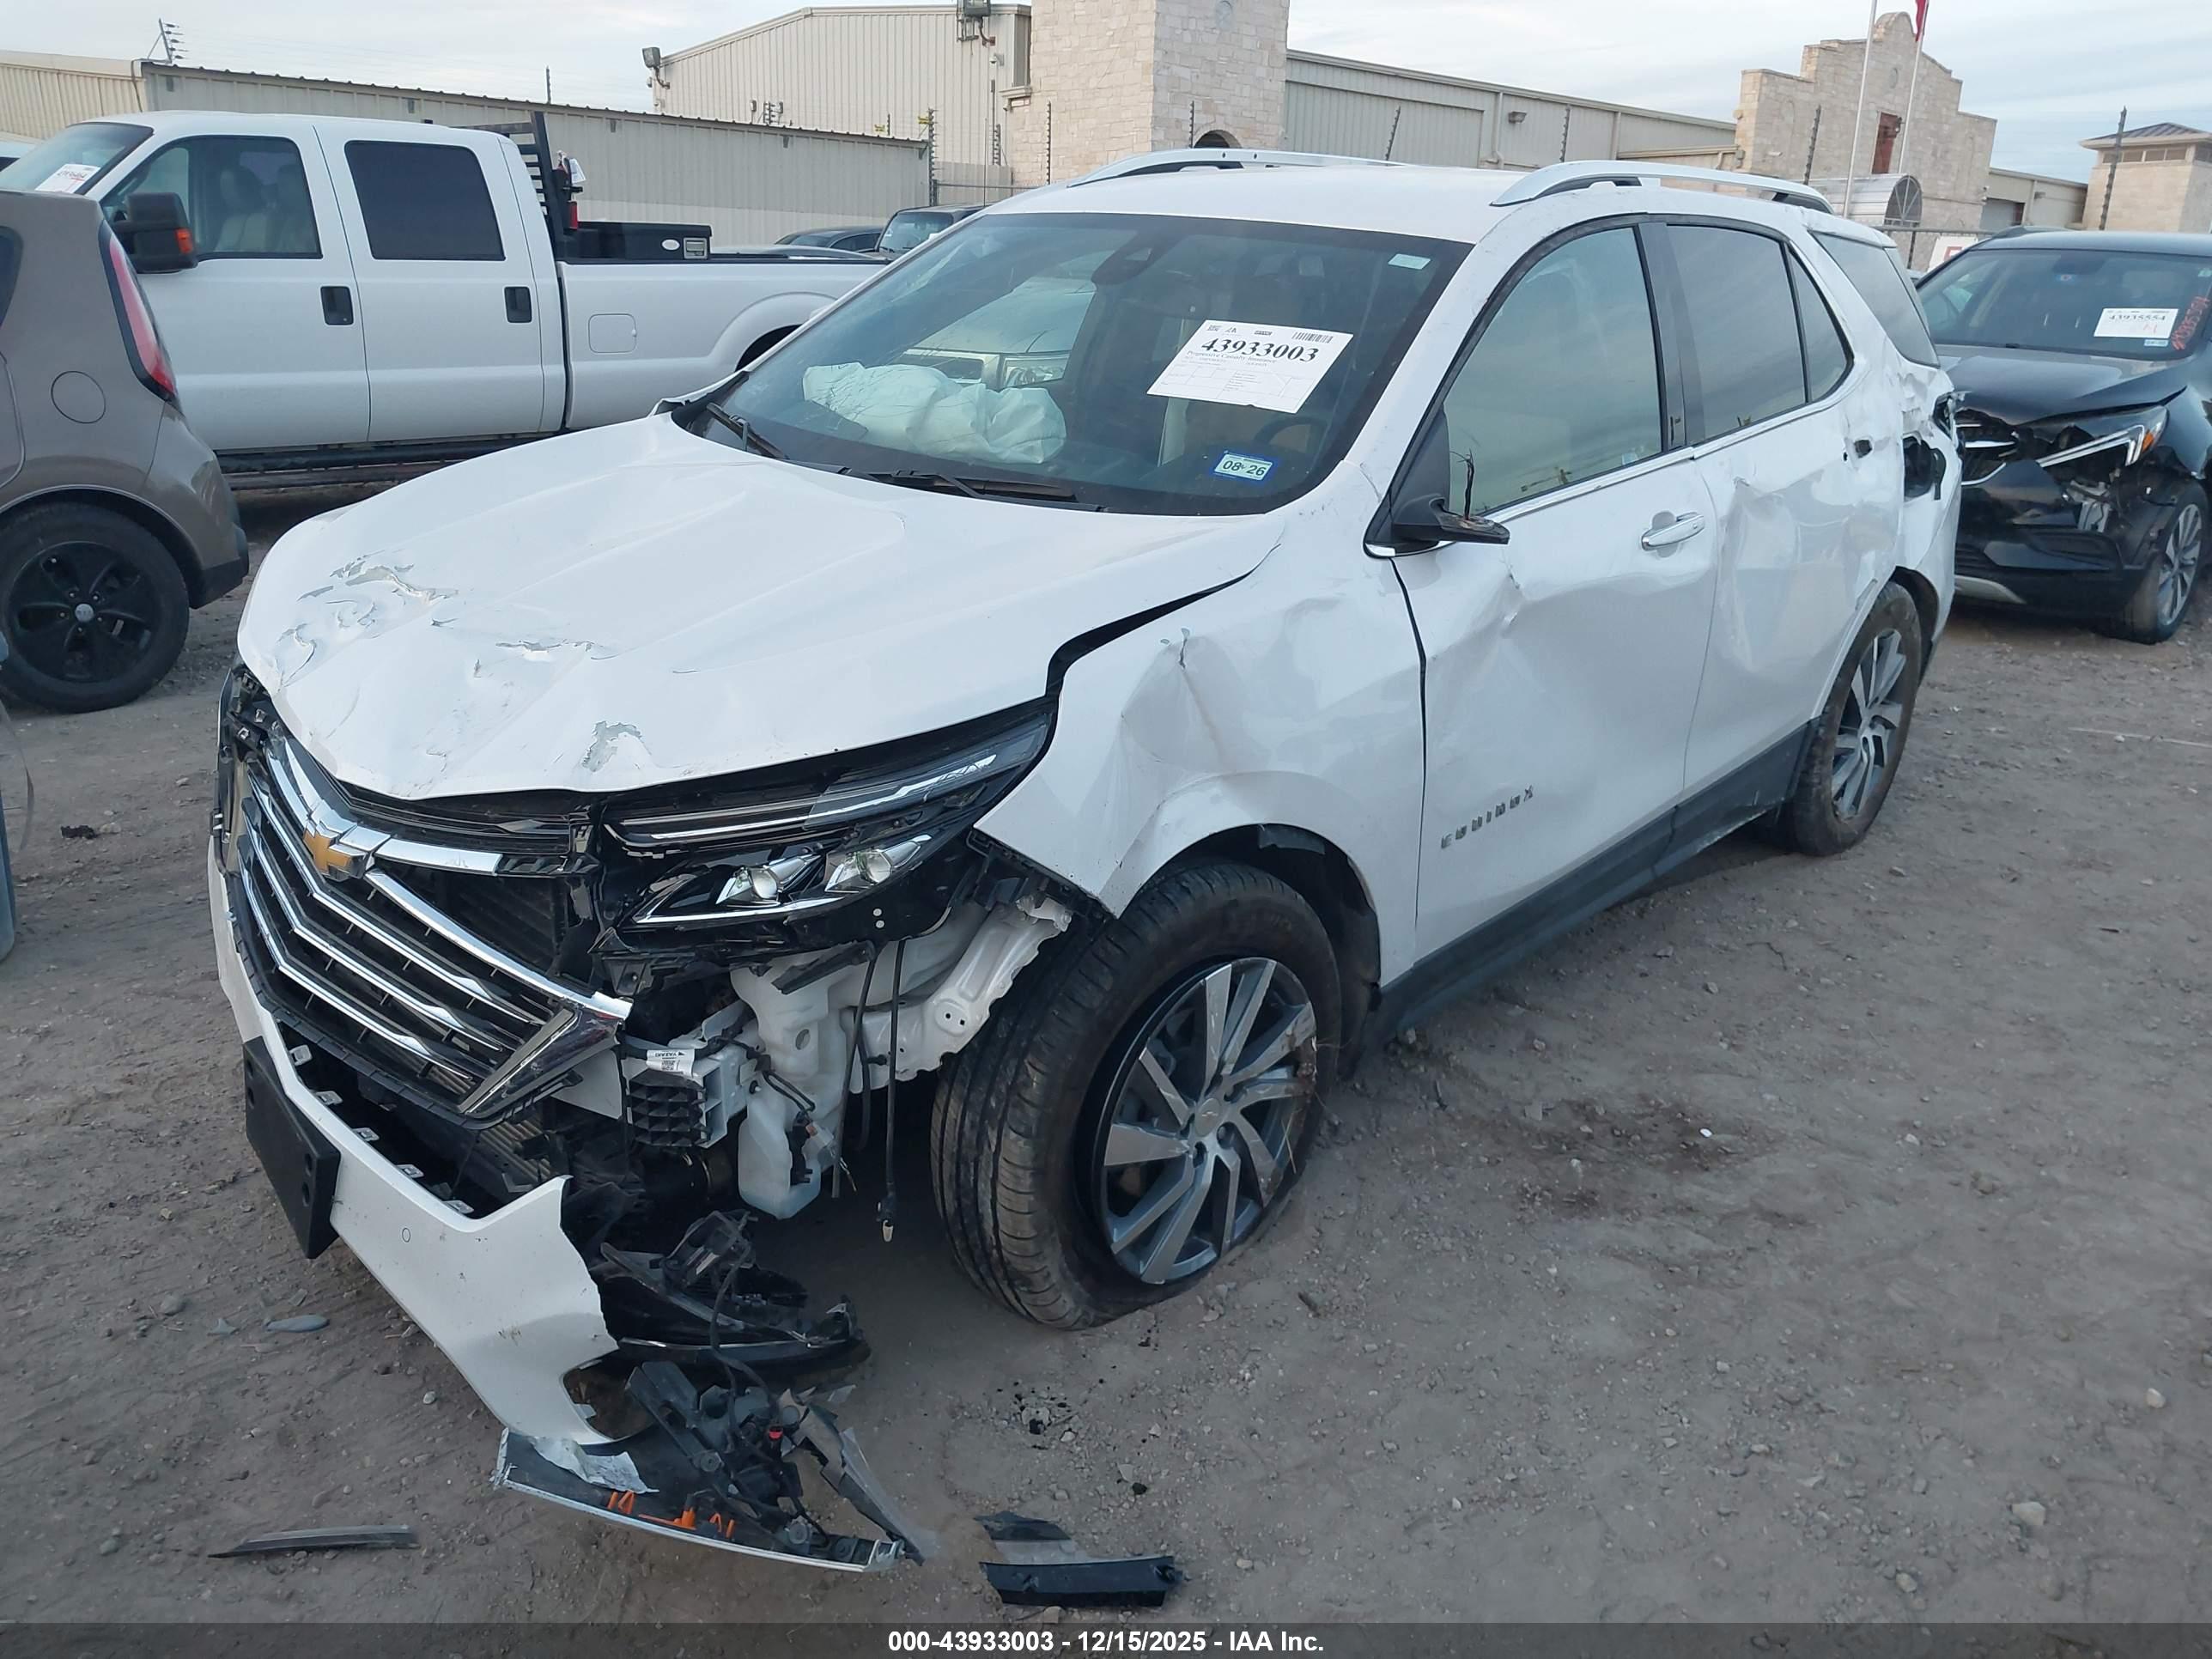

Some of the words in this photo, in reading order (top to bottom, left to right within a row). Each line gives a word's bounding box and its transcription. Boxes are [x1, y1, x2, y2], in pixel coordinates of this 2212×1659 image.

[1201, 337, 1319, 363] 43933003
[1222, 460, 1243, 471] 08
[1246, 465, 1267, 477] 26
[1440, 784, 1534, 848] EQUINOX
